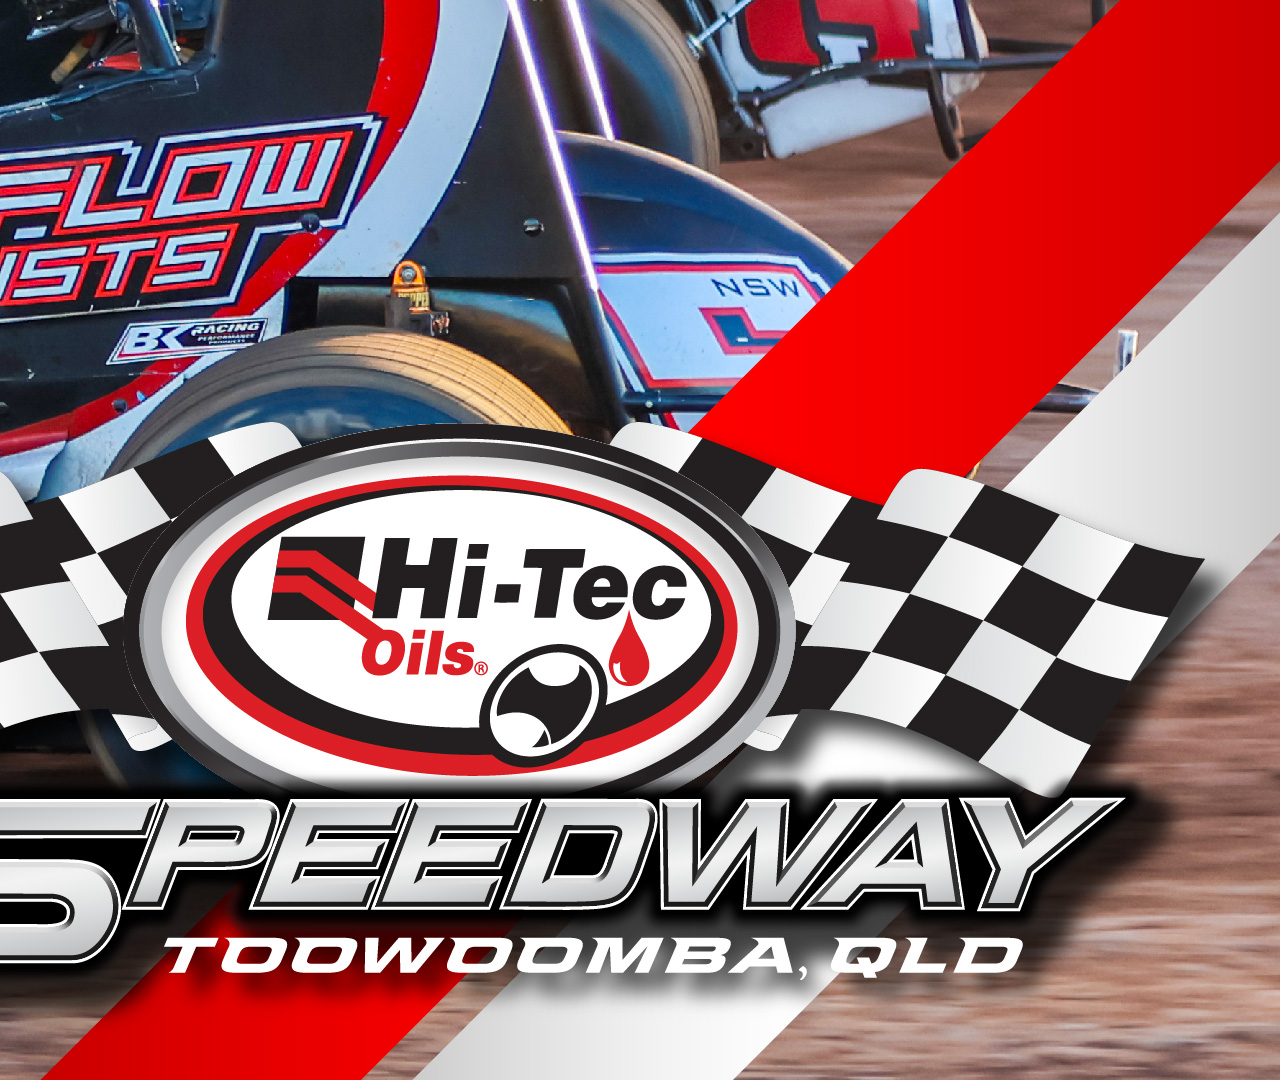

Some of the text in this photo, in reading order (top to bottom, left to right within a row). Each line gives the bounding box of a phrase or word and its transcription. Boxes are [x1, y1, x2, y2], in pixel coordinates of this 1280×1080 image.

[710, 278, 800, 297] NSW
[121, 322, 260, 355] BK RACING
